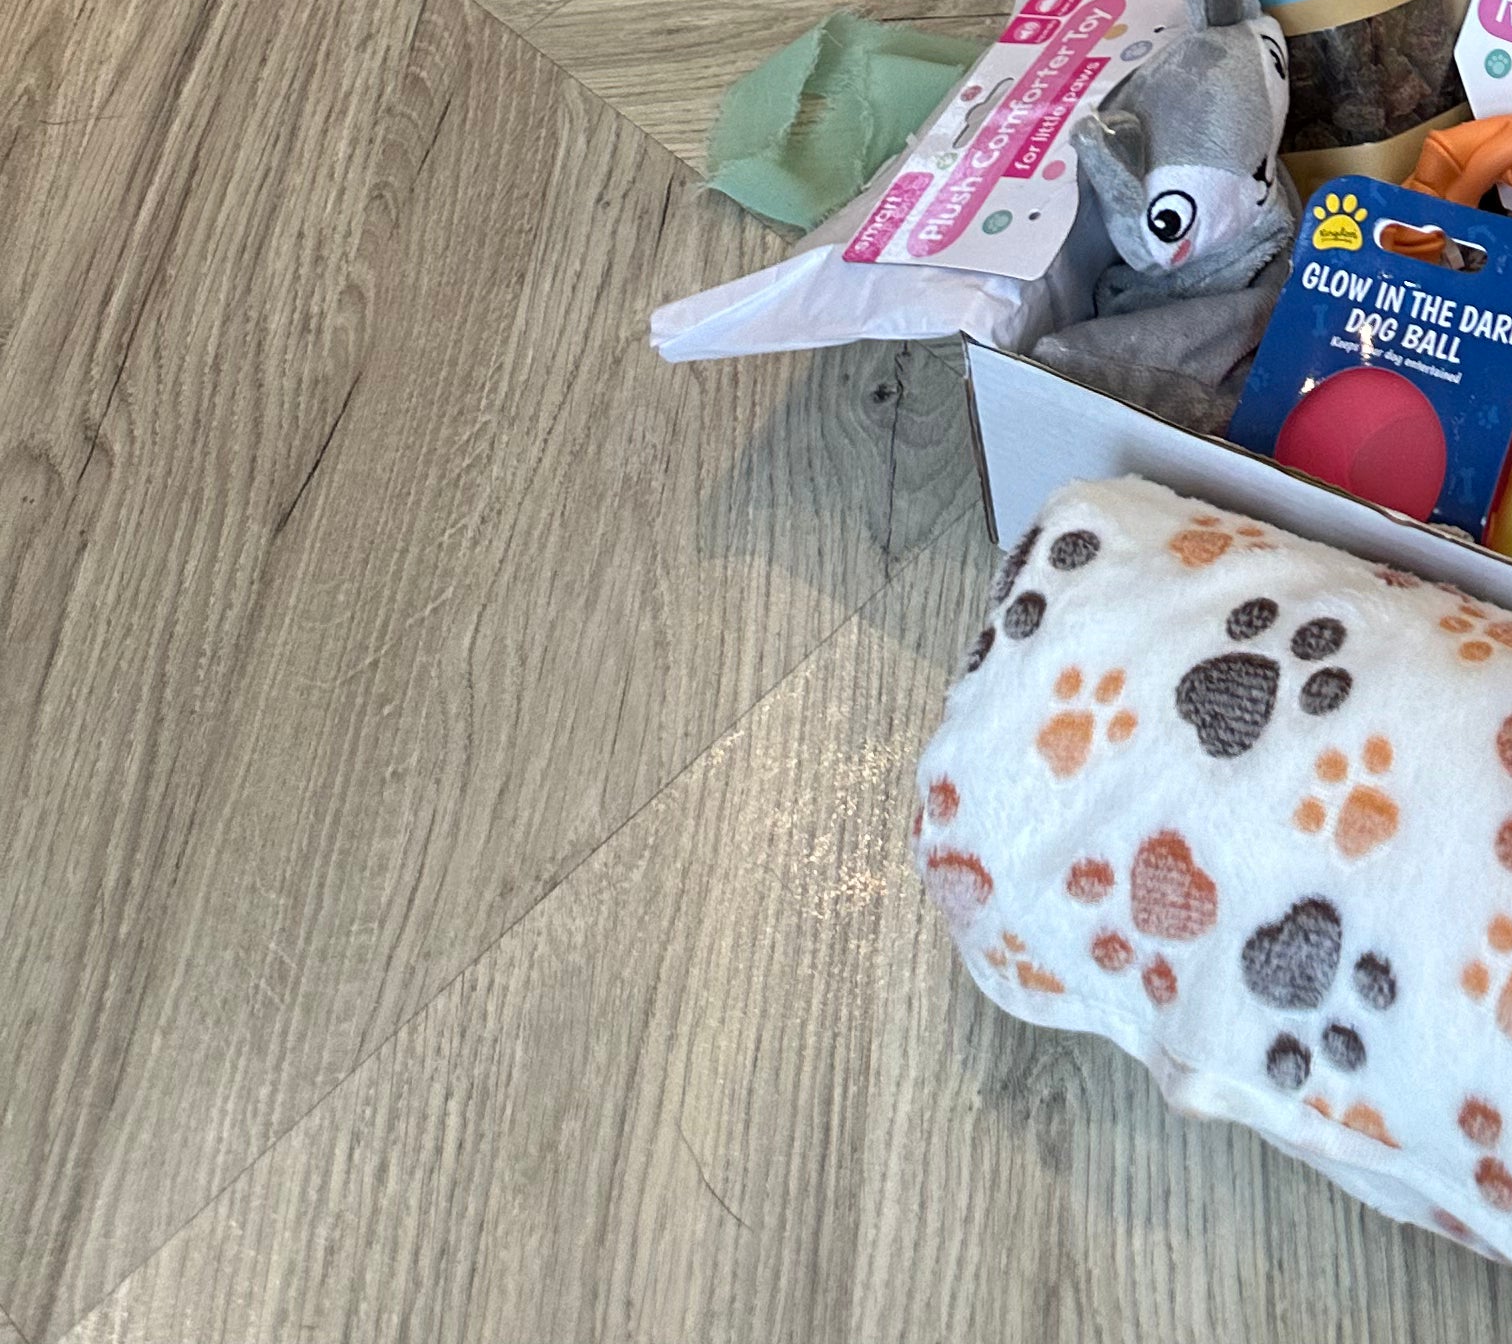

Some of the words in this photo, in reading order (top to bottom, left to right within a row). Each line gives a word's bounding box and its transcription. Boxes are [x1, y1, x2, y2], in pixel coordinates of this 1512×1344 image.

[917, 174, 984, 242] Plush
[971, 43, 1076, 170] Comforter
[1068, 7, 1113, 53] Toy
[1014, 147, 1042, 171] for
[1033, 98, 1067, 145] little
[1062, 61, 1101, 106] paws
[854, 192, 903, 251] smart
[1302, 262, 1373, 302] GLOW
[1374, 280, 1407, 314] IN
[1411, 290, 1457, 329] THE
[1345, 307, 1398, 342] DOG
[1401, 323, 1462, 365] BALL
